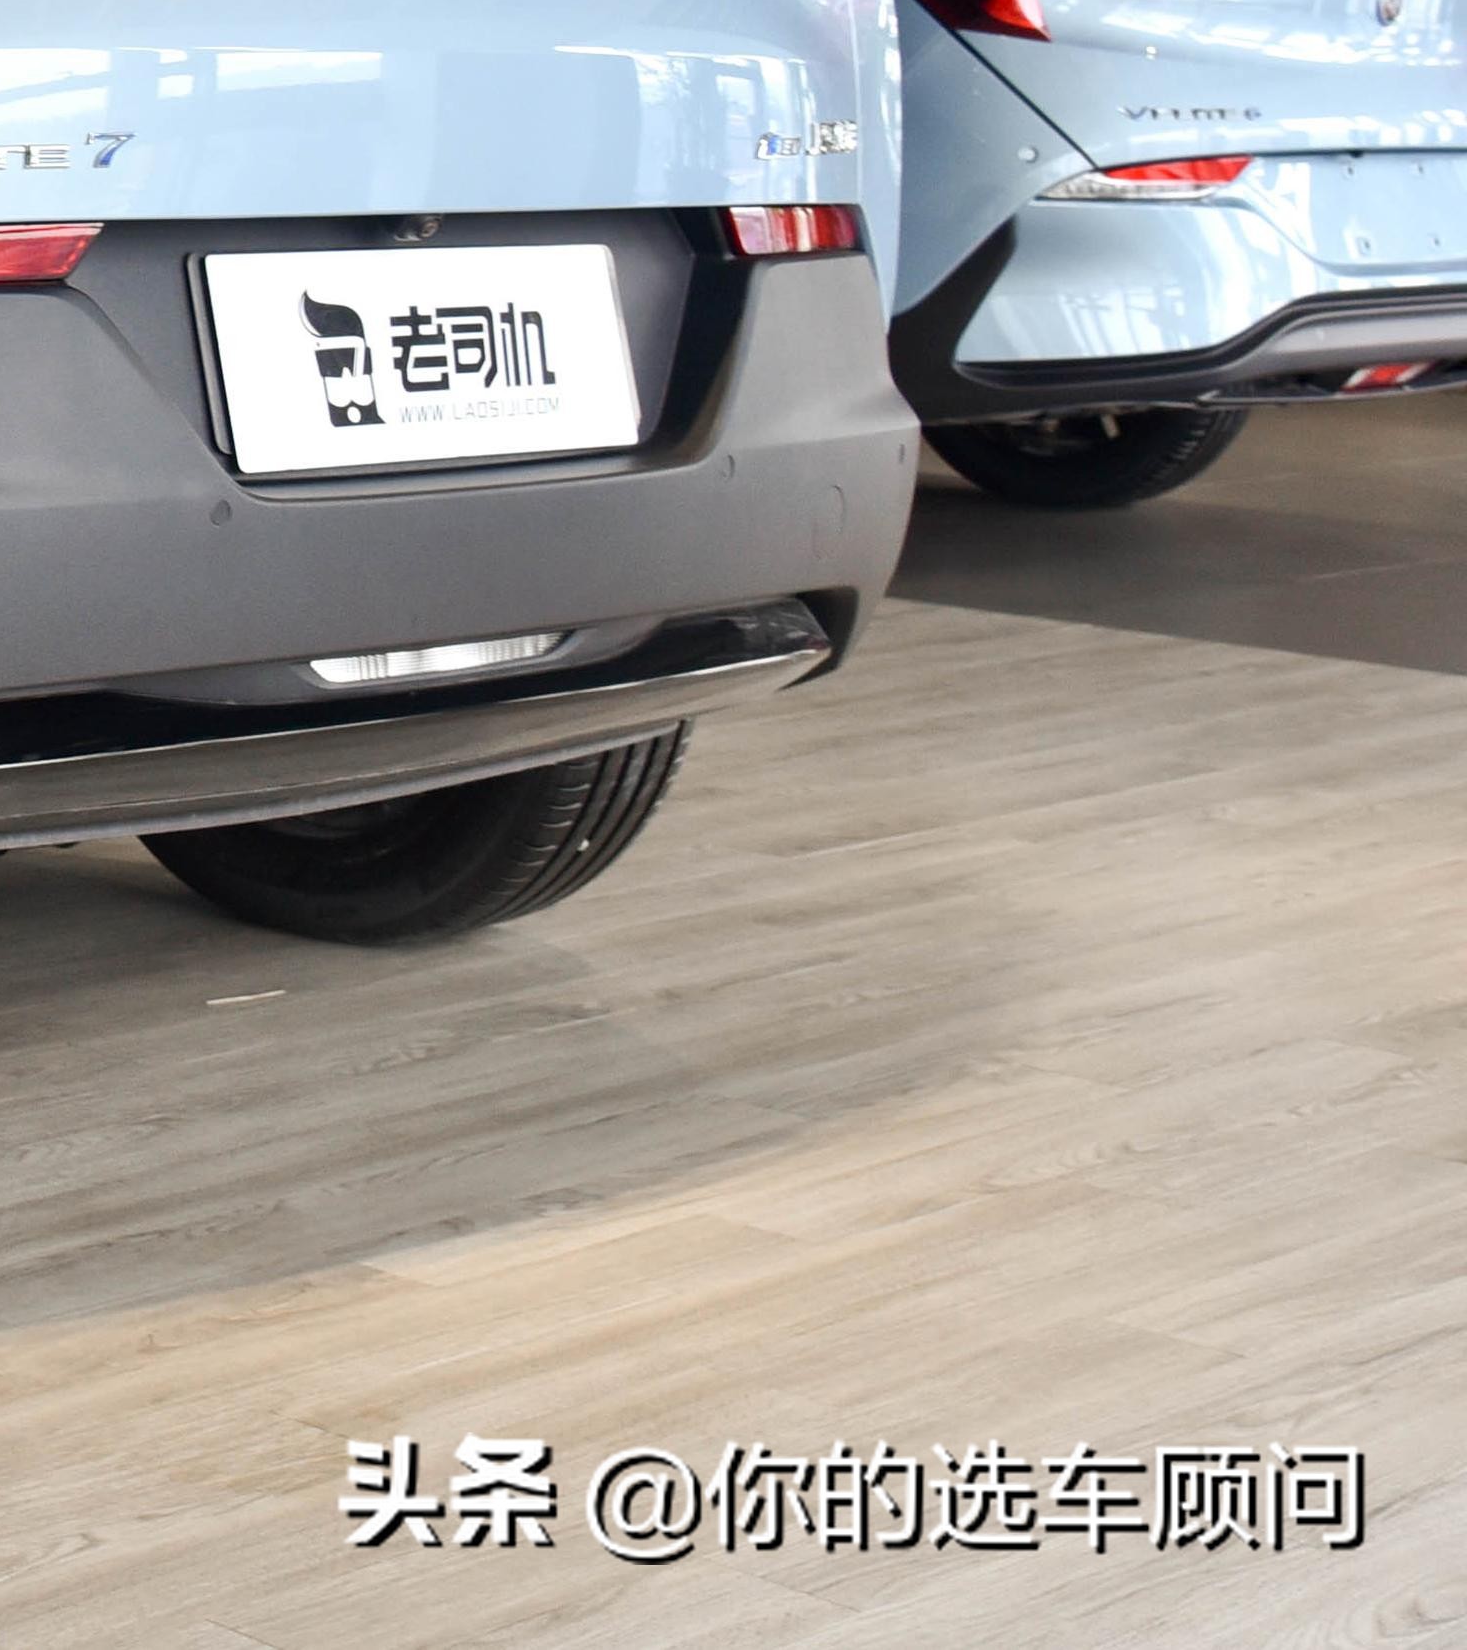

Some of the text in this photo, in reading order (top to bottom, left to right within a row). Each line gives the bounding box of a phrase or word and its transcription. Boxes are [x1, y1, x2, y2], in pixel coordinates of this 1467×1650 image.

[85, 132, 138, 169] 7
[389, 301, 557, 393] 老司机
